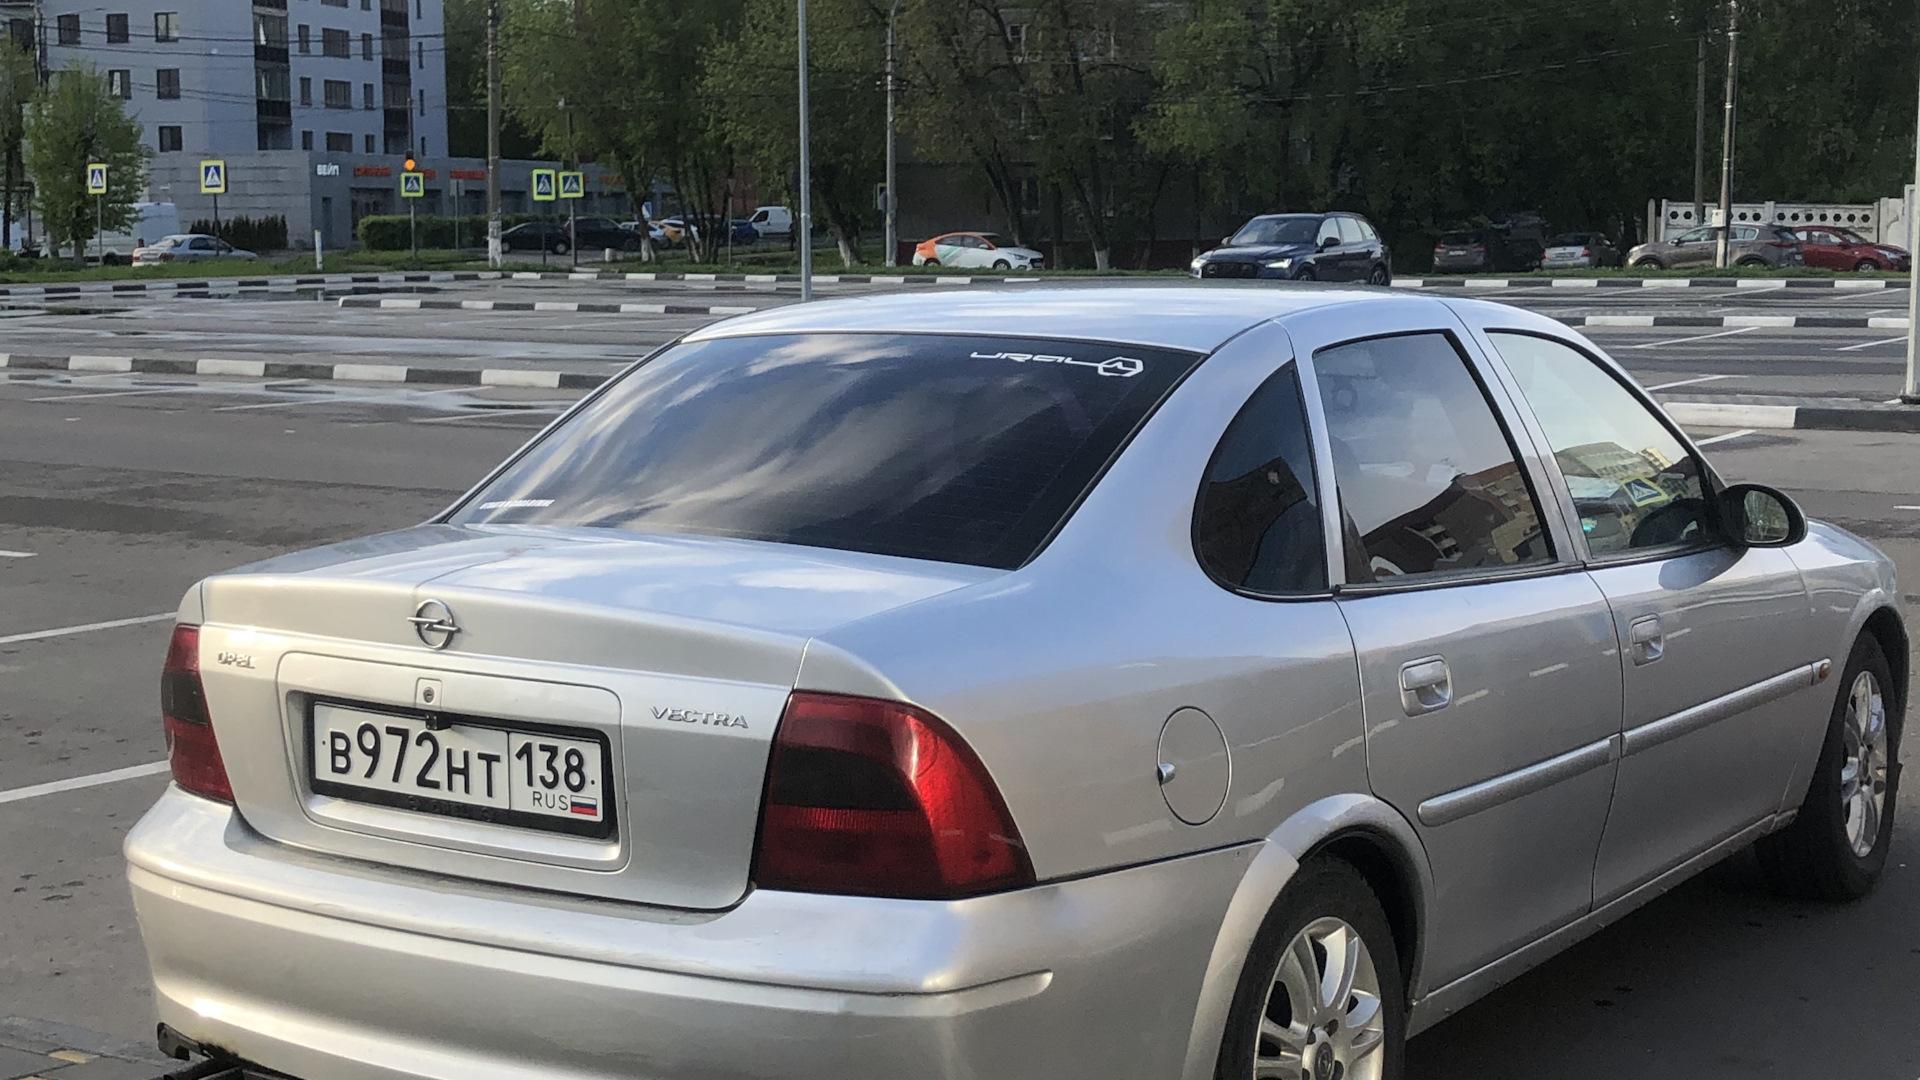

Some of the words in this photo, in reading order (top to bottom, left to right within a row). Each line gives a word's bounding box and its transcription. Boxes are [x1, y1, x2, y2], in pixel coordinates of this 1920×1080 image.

[316, 163, 340, 177] ВЕЙП
[217, 652, 256, 670] OPEL
[650, 705, 749, 729] VECTRA
[515, 741, 586, 793] 138
[532, 790, 569, 811] RUS
